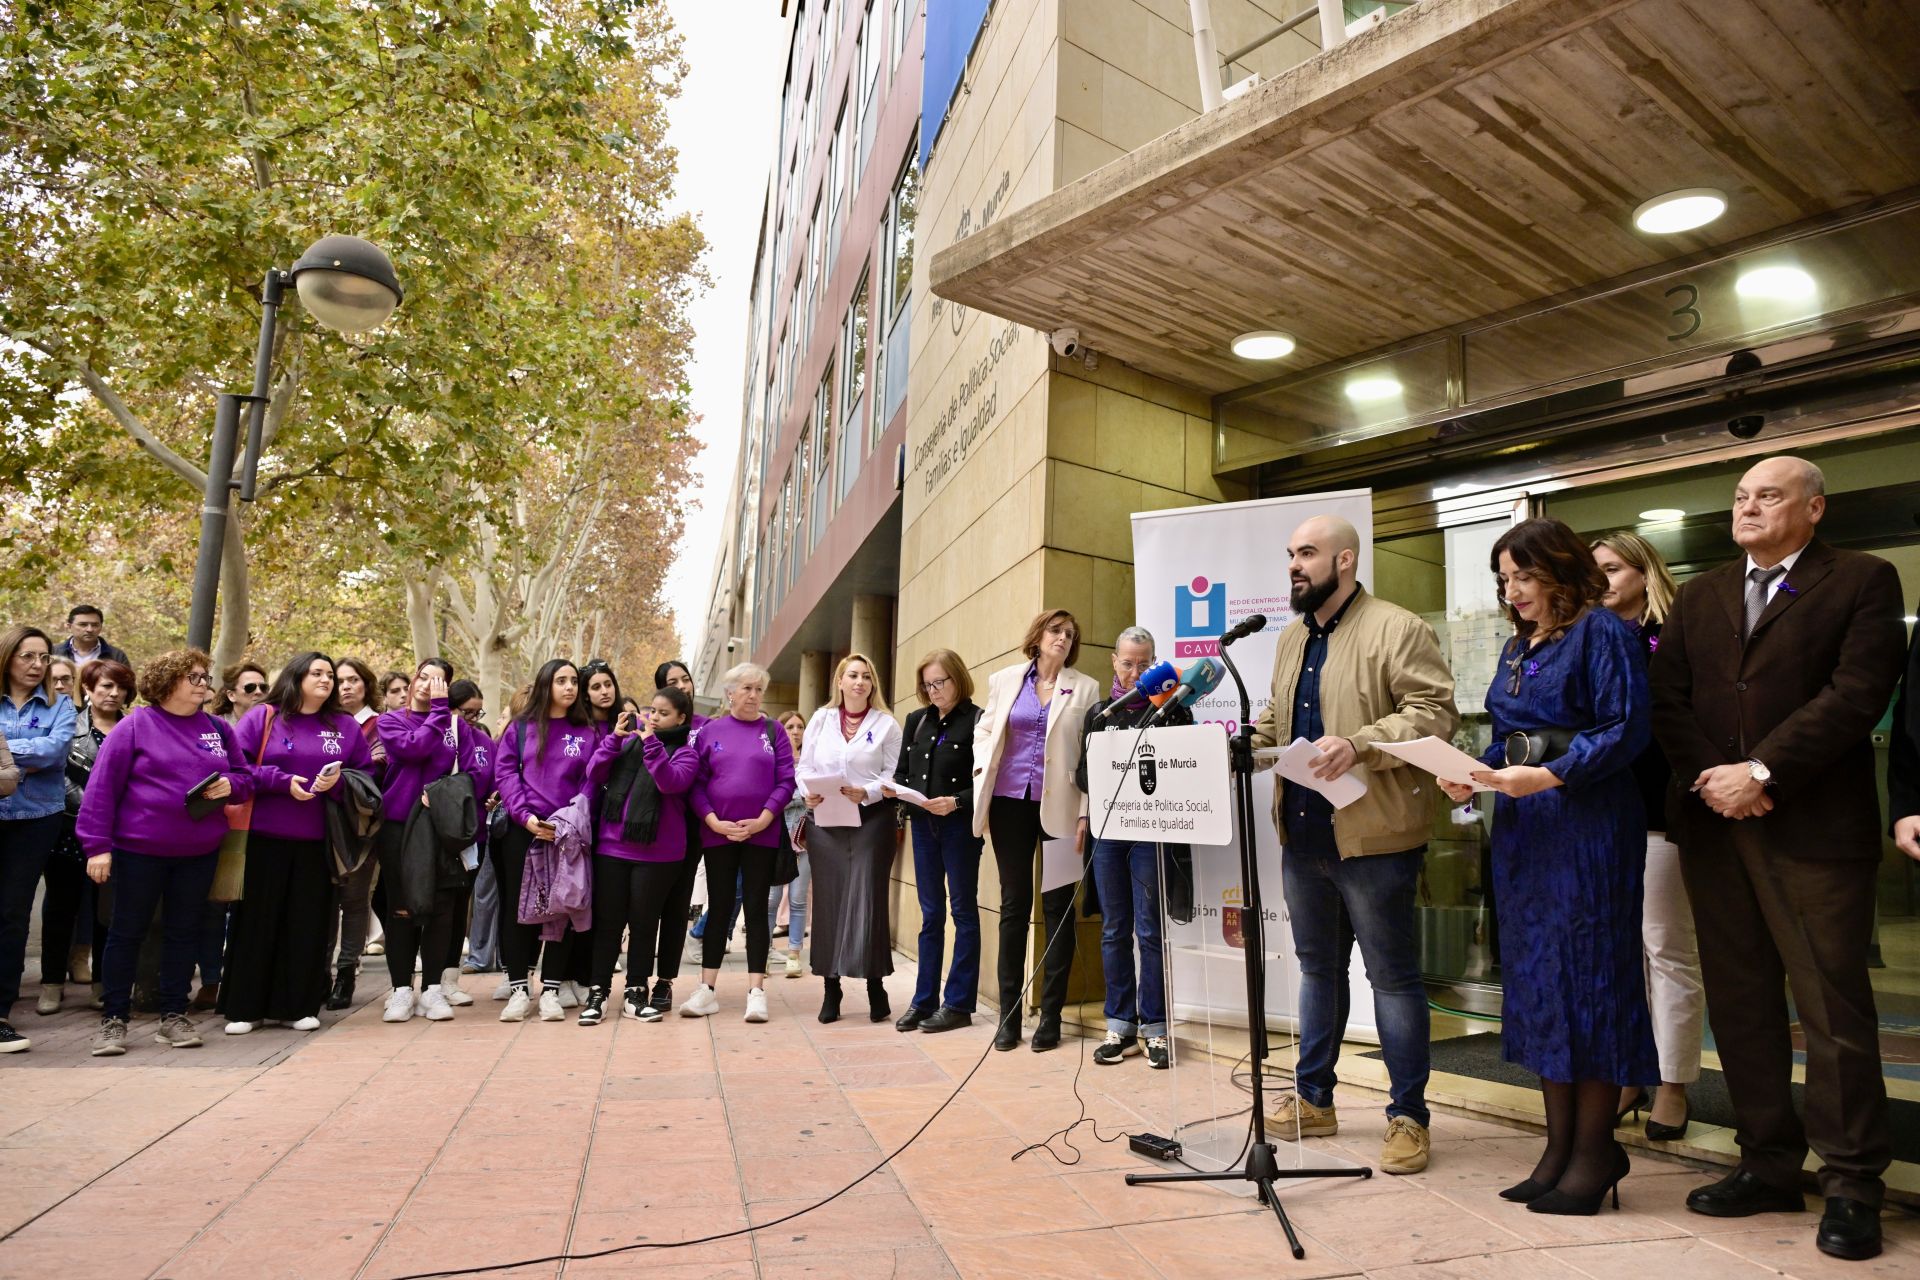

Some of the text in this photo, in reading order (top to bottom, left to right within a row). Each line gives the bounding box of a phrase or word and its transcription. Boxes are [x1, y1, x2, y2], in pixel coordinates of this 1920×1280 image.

[1664, 284, 1702, 341] 3
[947, 394, 957, 427] de
[925, 380, 998, 497] Familias e Igualdad
[1183, 643, 1218, 655] CAVI
[1158, 757, 1168, 769] de
[1169, 756, 1197, 769] Murcia
[1142, 798, 1153, 811] de
[1185, 798, 1213, 814] Social,
[1120, 816, 1195, 832] Familias e Igualdad
